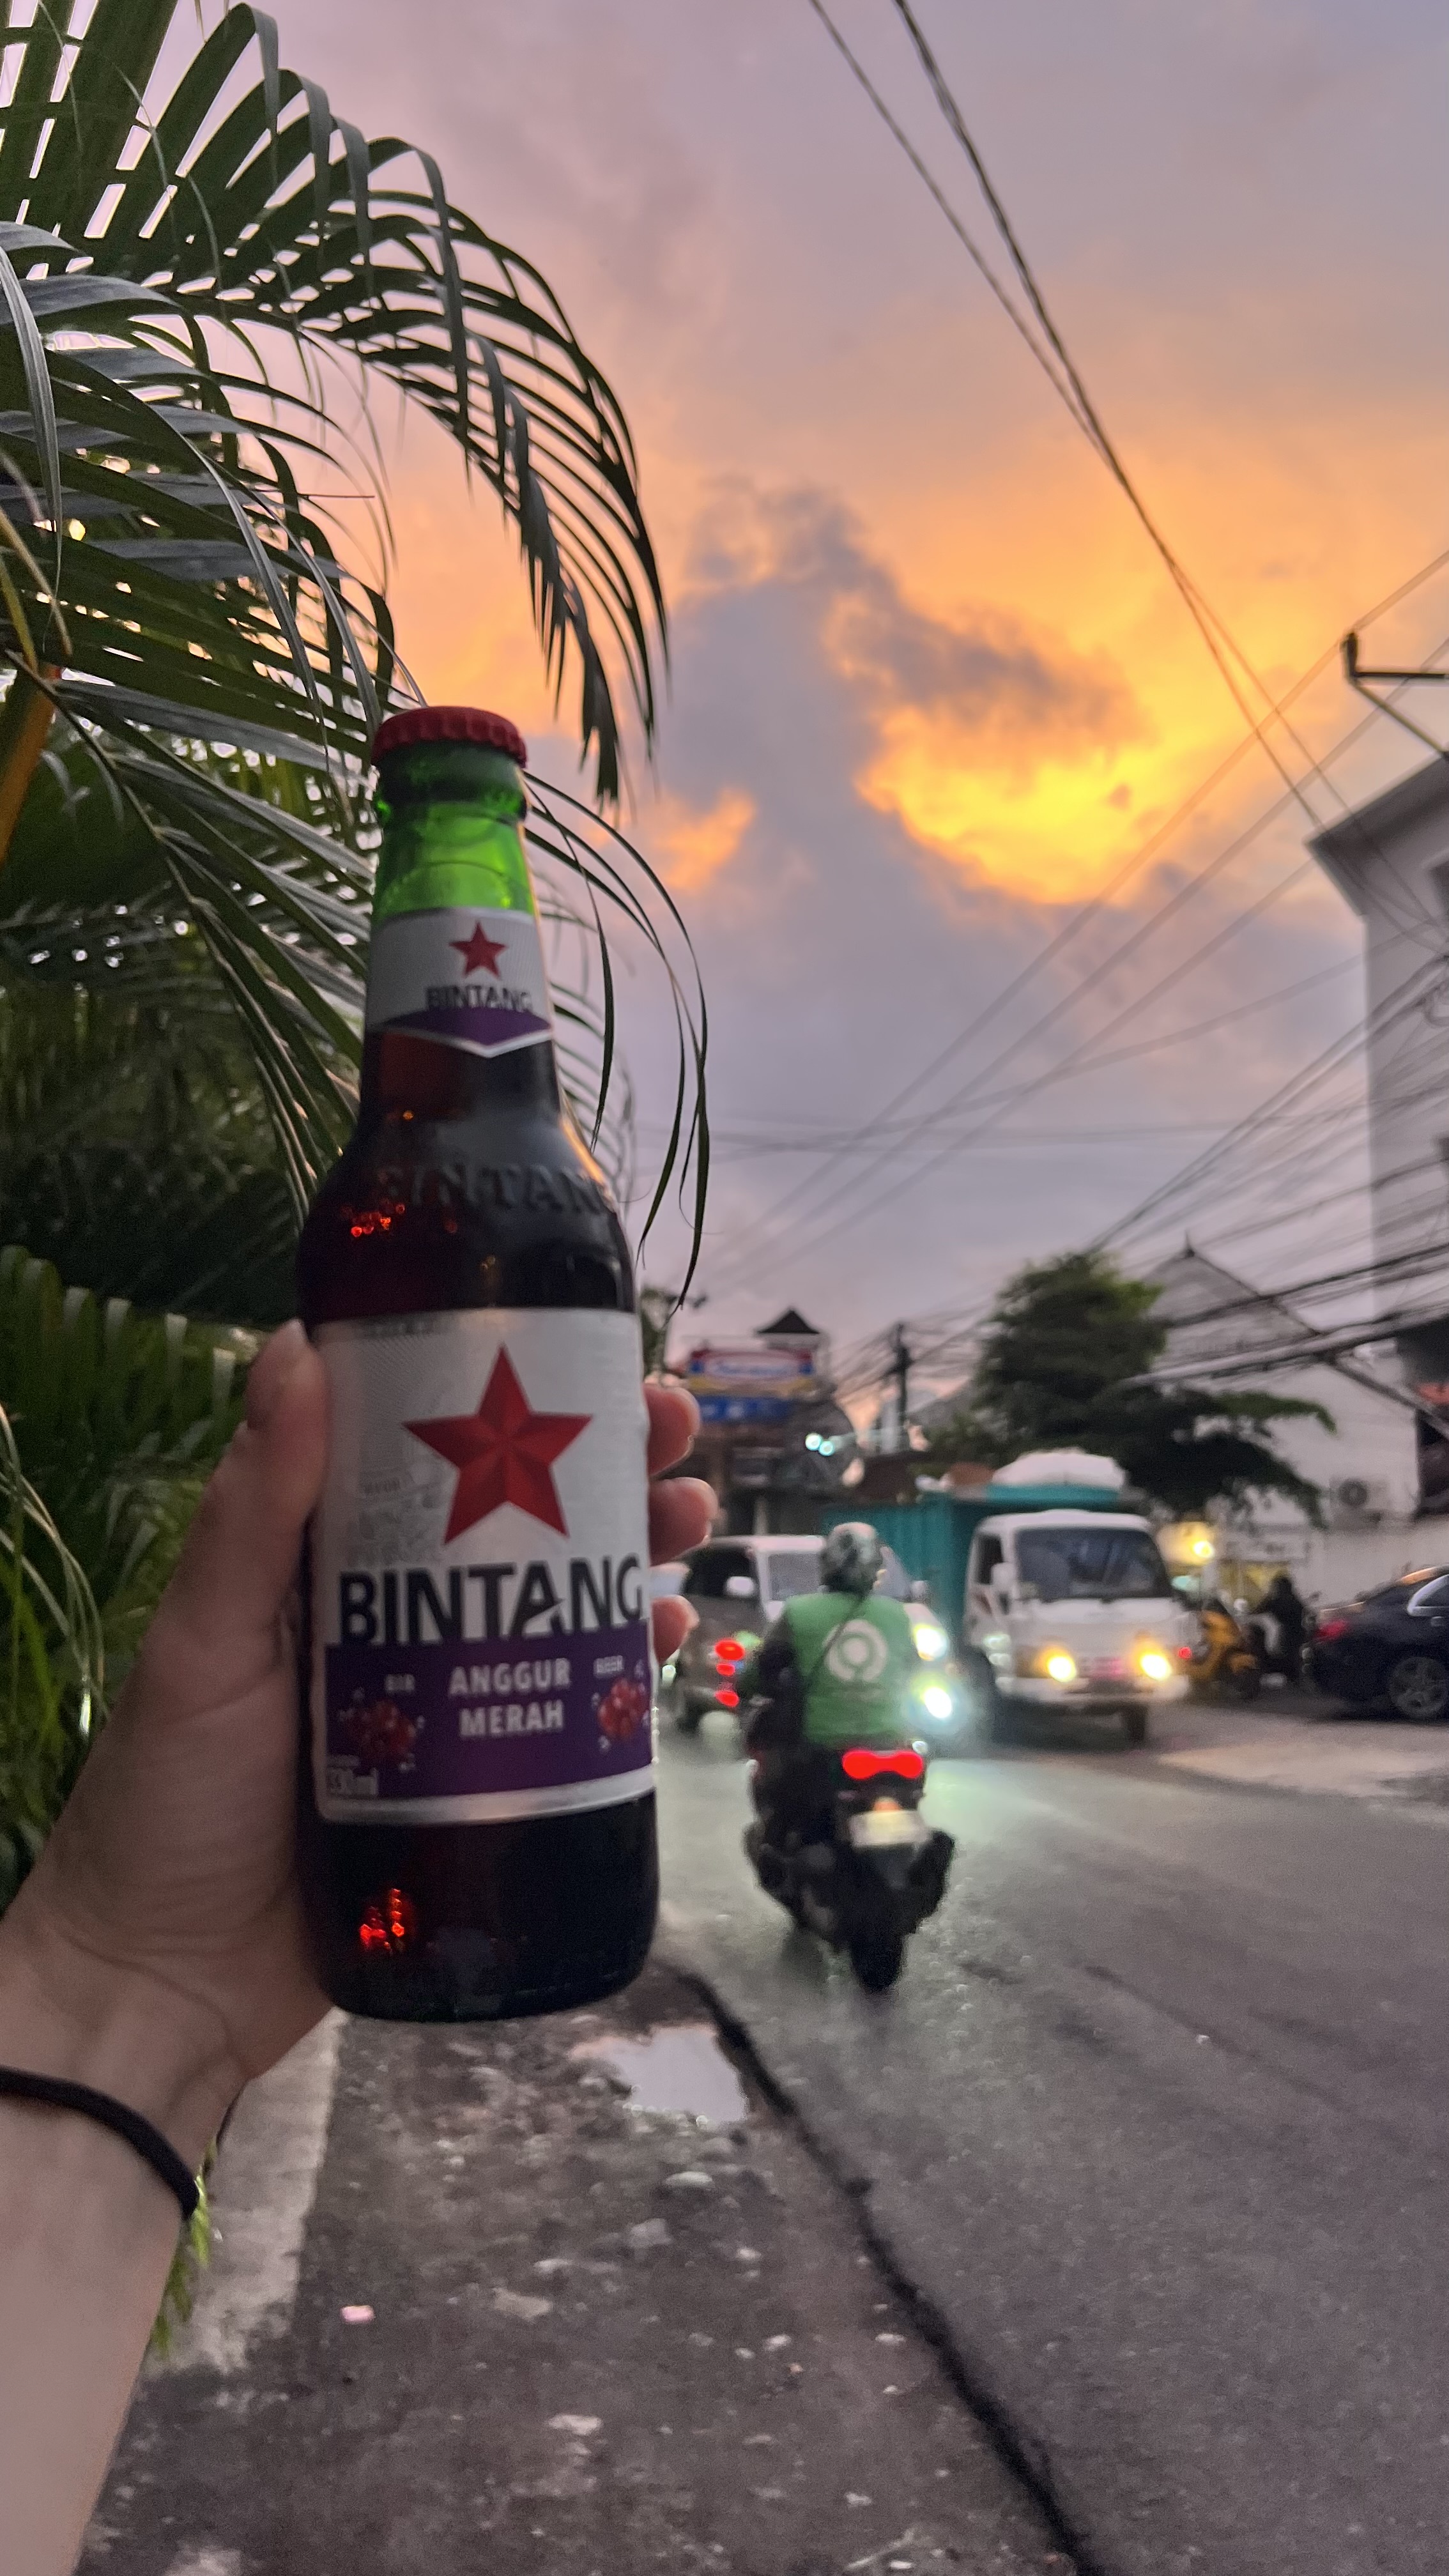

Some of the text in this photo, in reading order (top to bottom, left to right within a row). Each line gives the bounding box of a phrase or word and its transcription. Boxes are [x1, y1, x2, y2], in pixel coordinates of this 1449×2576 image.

[426, 986, 532, 1012] BINTANG
[379, 1163, 606, 1213] BINTAN
[340, 1554, 642, 1644] BINTANG
[450, 1658, 570, 1694] ANGGUR
[459, 1699, 564, 1737] MERAH
